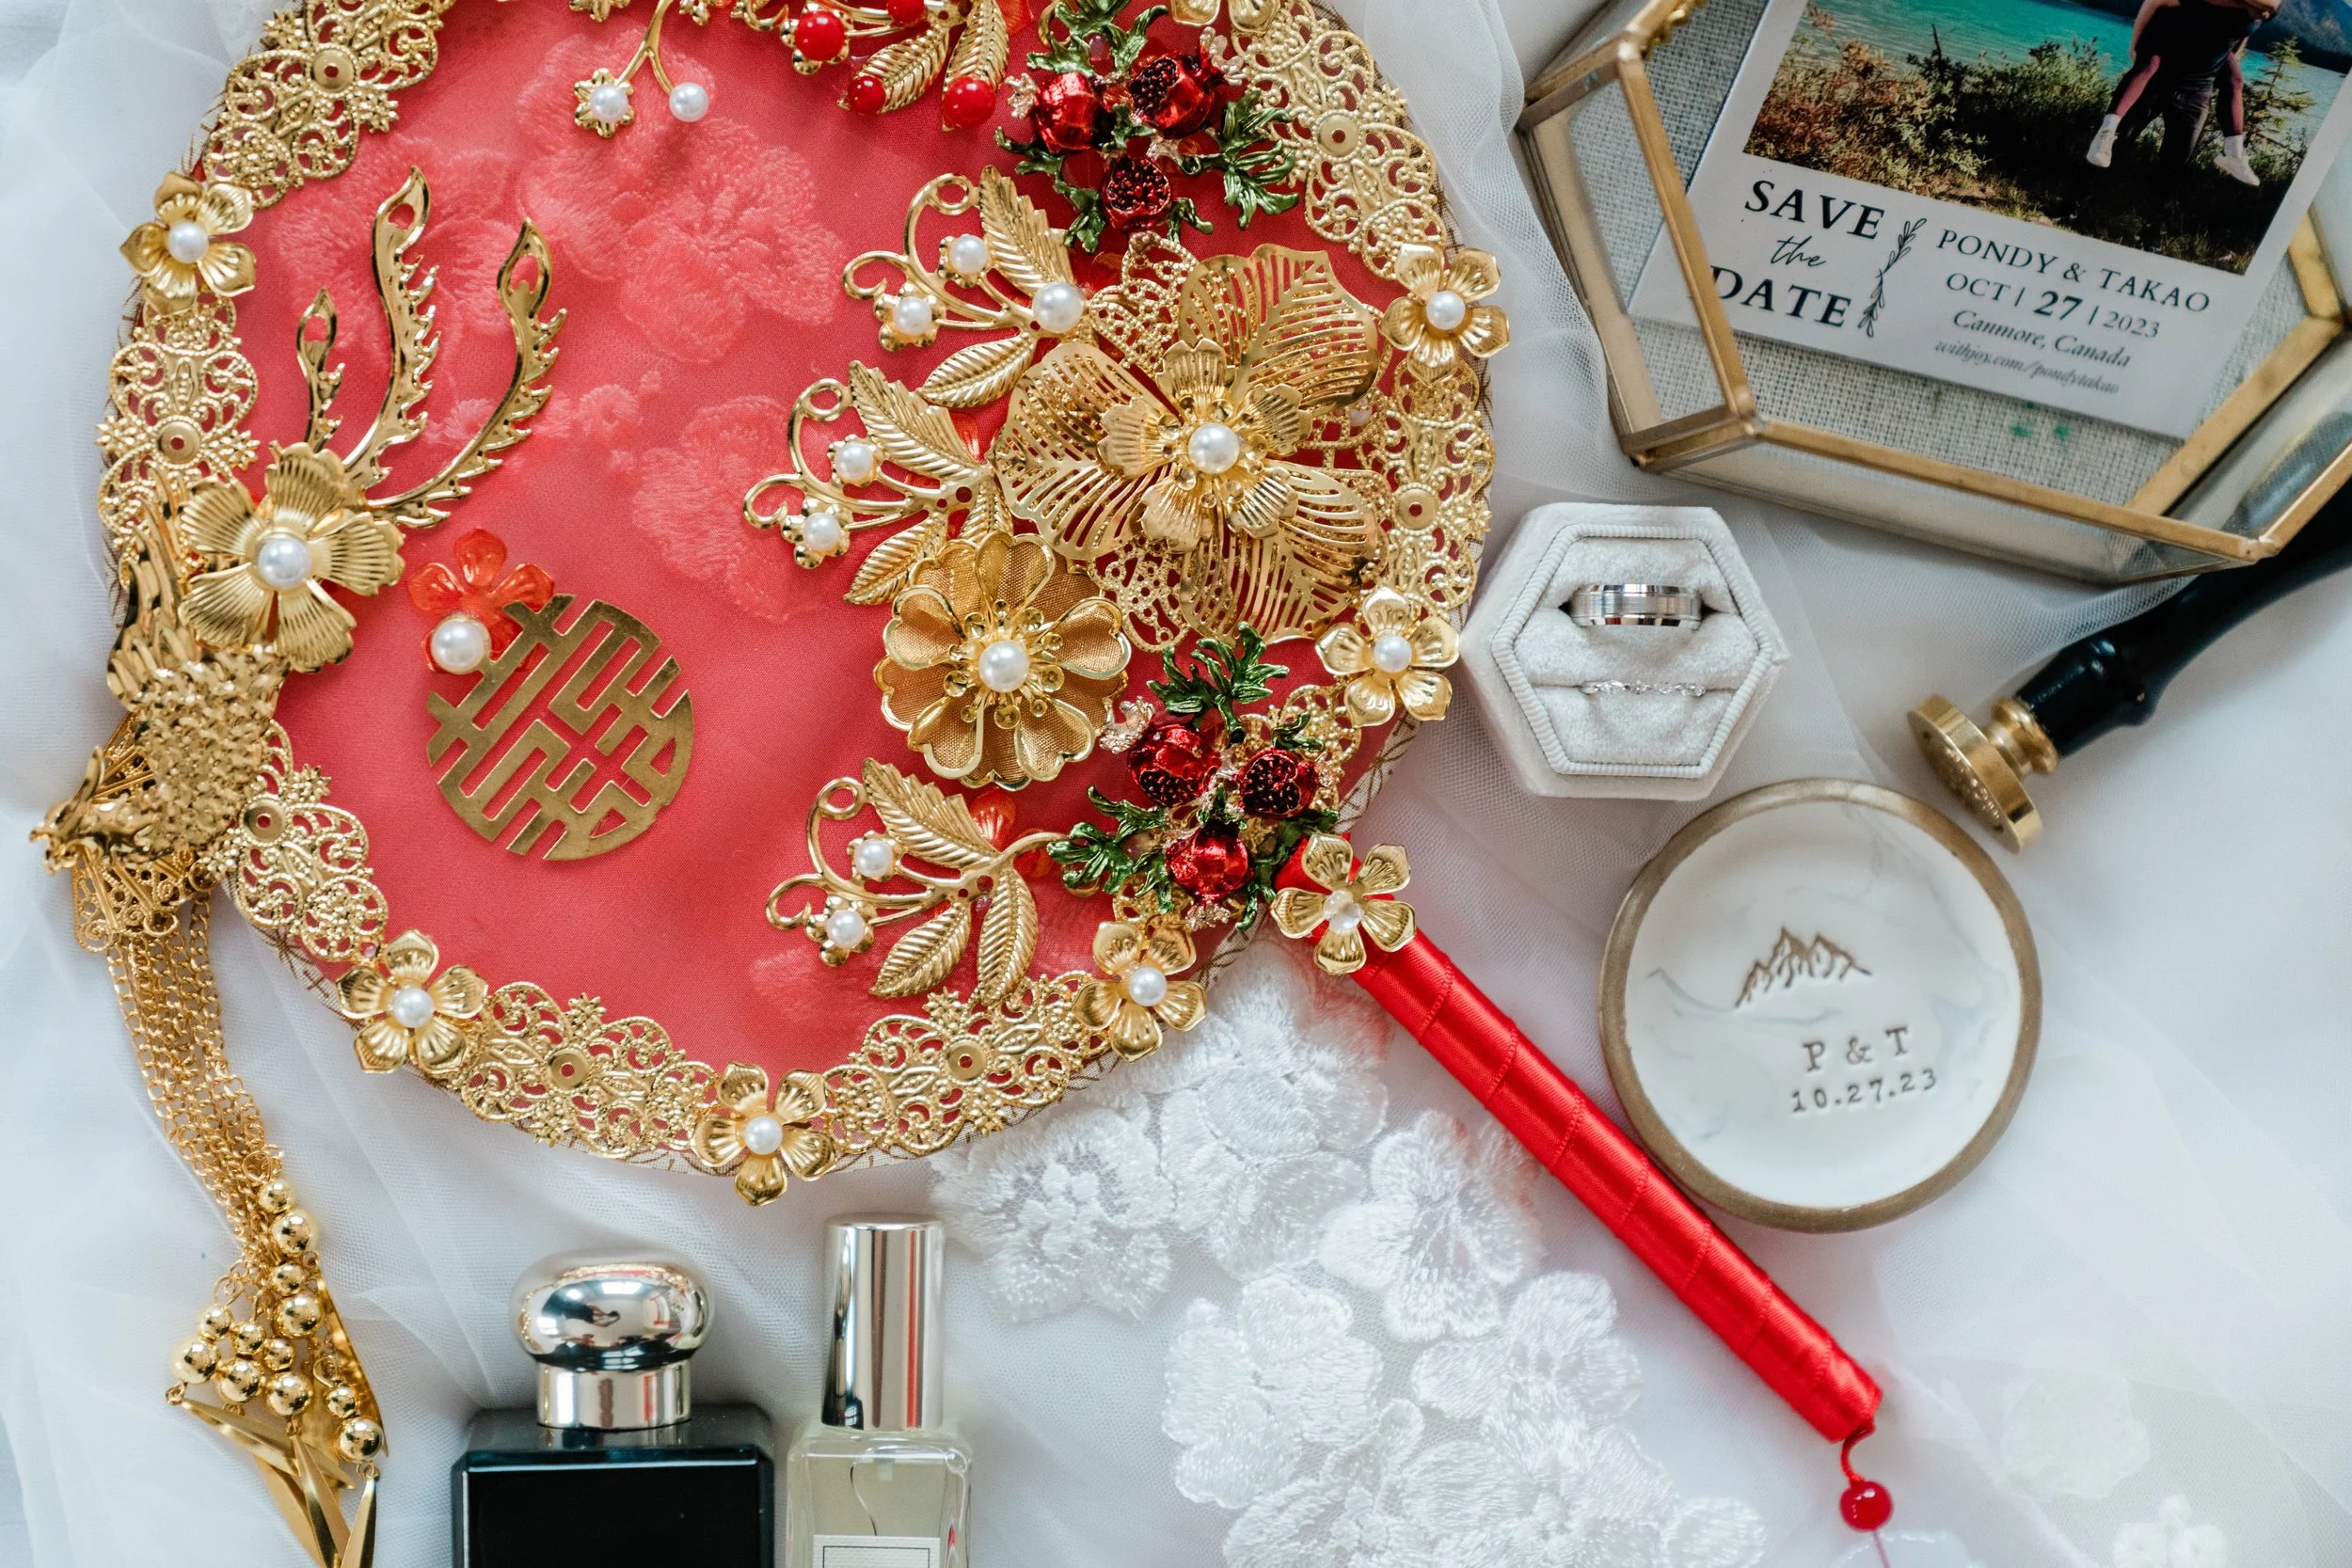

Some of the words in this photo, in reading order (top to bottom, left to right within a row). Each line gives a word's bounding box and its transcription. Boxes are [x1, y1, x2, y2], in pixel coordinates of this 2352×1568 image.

[1744, 180, 1885, 240] SAVE
[1771, 235, 1826, 267] the
[1936, 229, 2058, 274] PONDY
[2063, 262, 2087, 282] &
[2100, 268, 2210, 312] TAKAO
[1710, 265, 1852, 327] DATE
[1946, 272, 2011, 302] OCT
[2033, 290, 2084, 321] 27
[2103, 310, 2161, 339] 2023
[1953, 309, 2046, 349] Canmore,
[2055, 334, 2132, 369] Canada
[1802, 1039, 1826, 1072] P
[1846, 1036, 1873, 1065] &
[1884, 1024, 1909, 1056] T
[1790, 1068, 1937, 1113] 10.27.23
